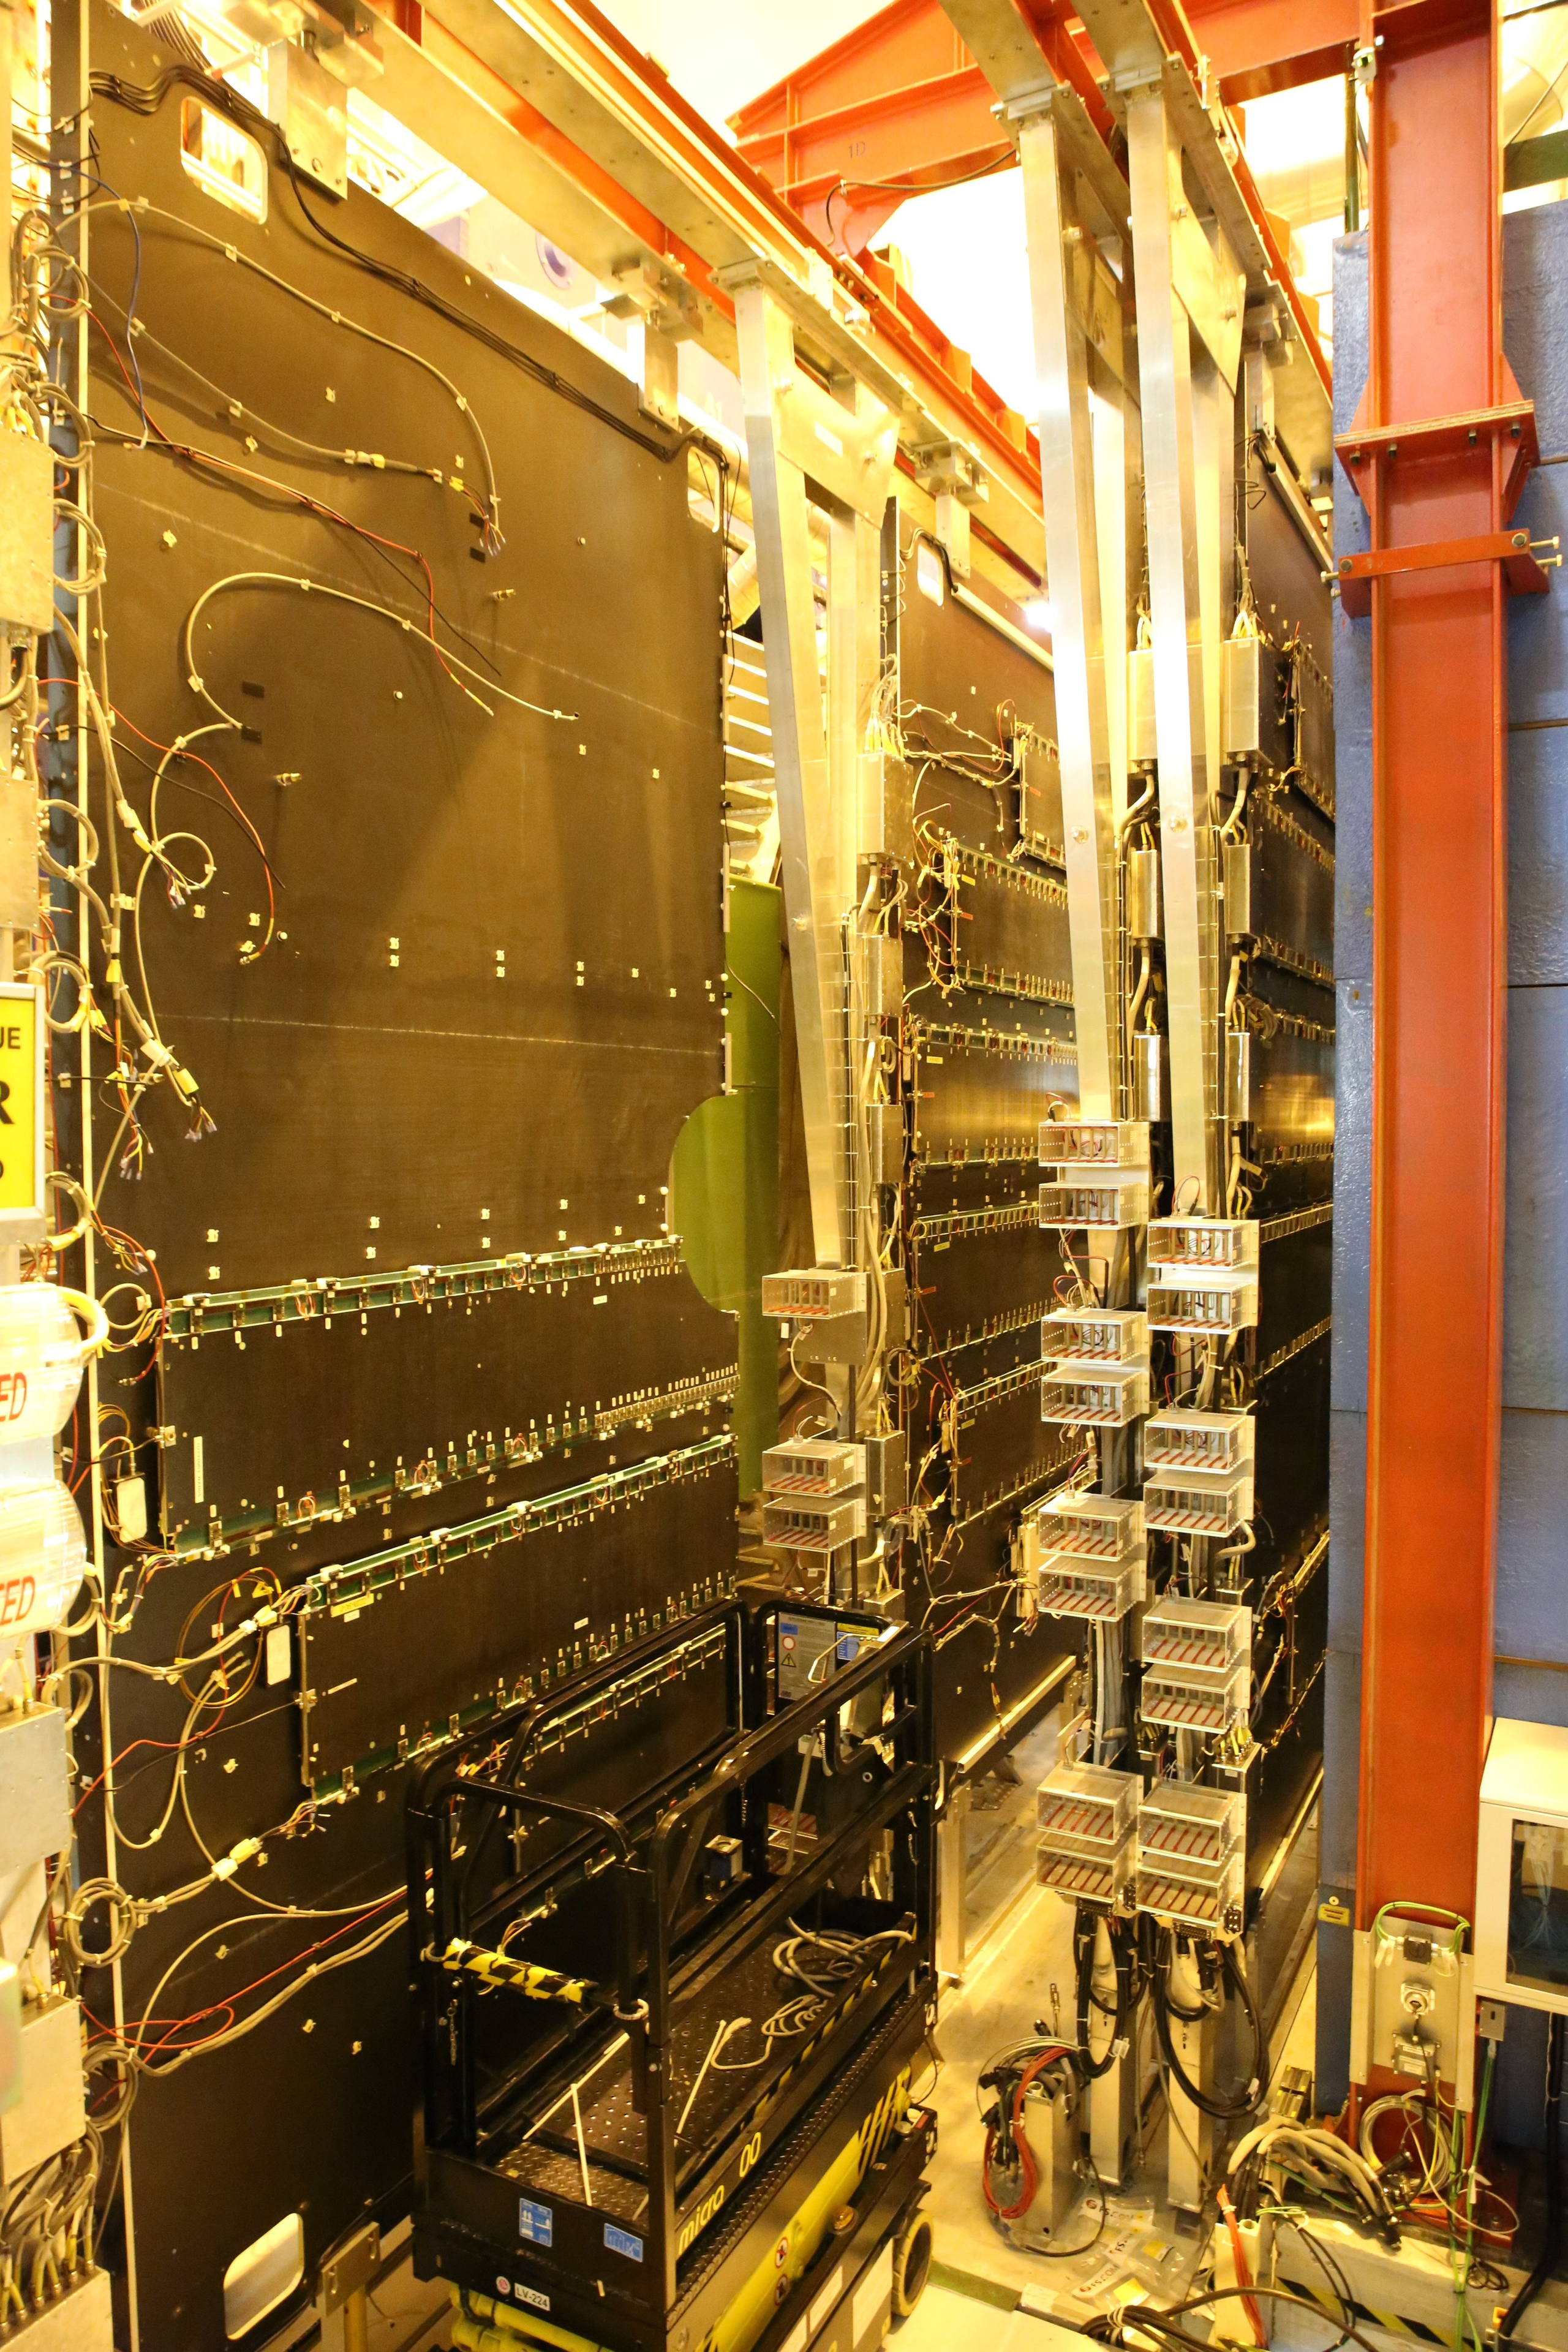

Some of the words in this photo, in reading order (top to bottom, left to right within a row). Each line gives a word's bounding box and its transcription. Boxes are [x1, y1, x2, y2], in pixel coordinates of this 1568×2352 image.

[0, 1575, 35, 1626] ED
[678, 2185, 725, 2256] micro
[516, 2288, 548, 2307] LV-224
